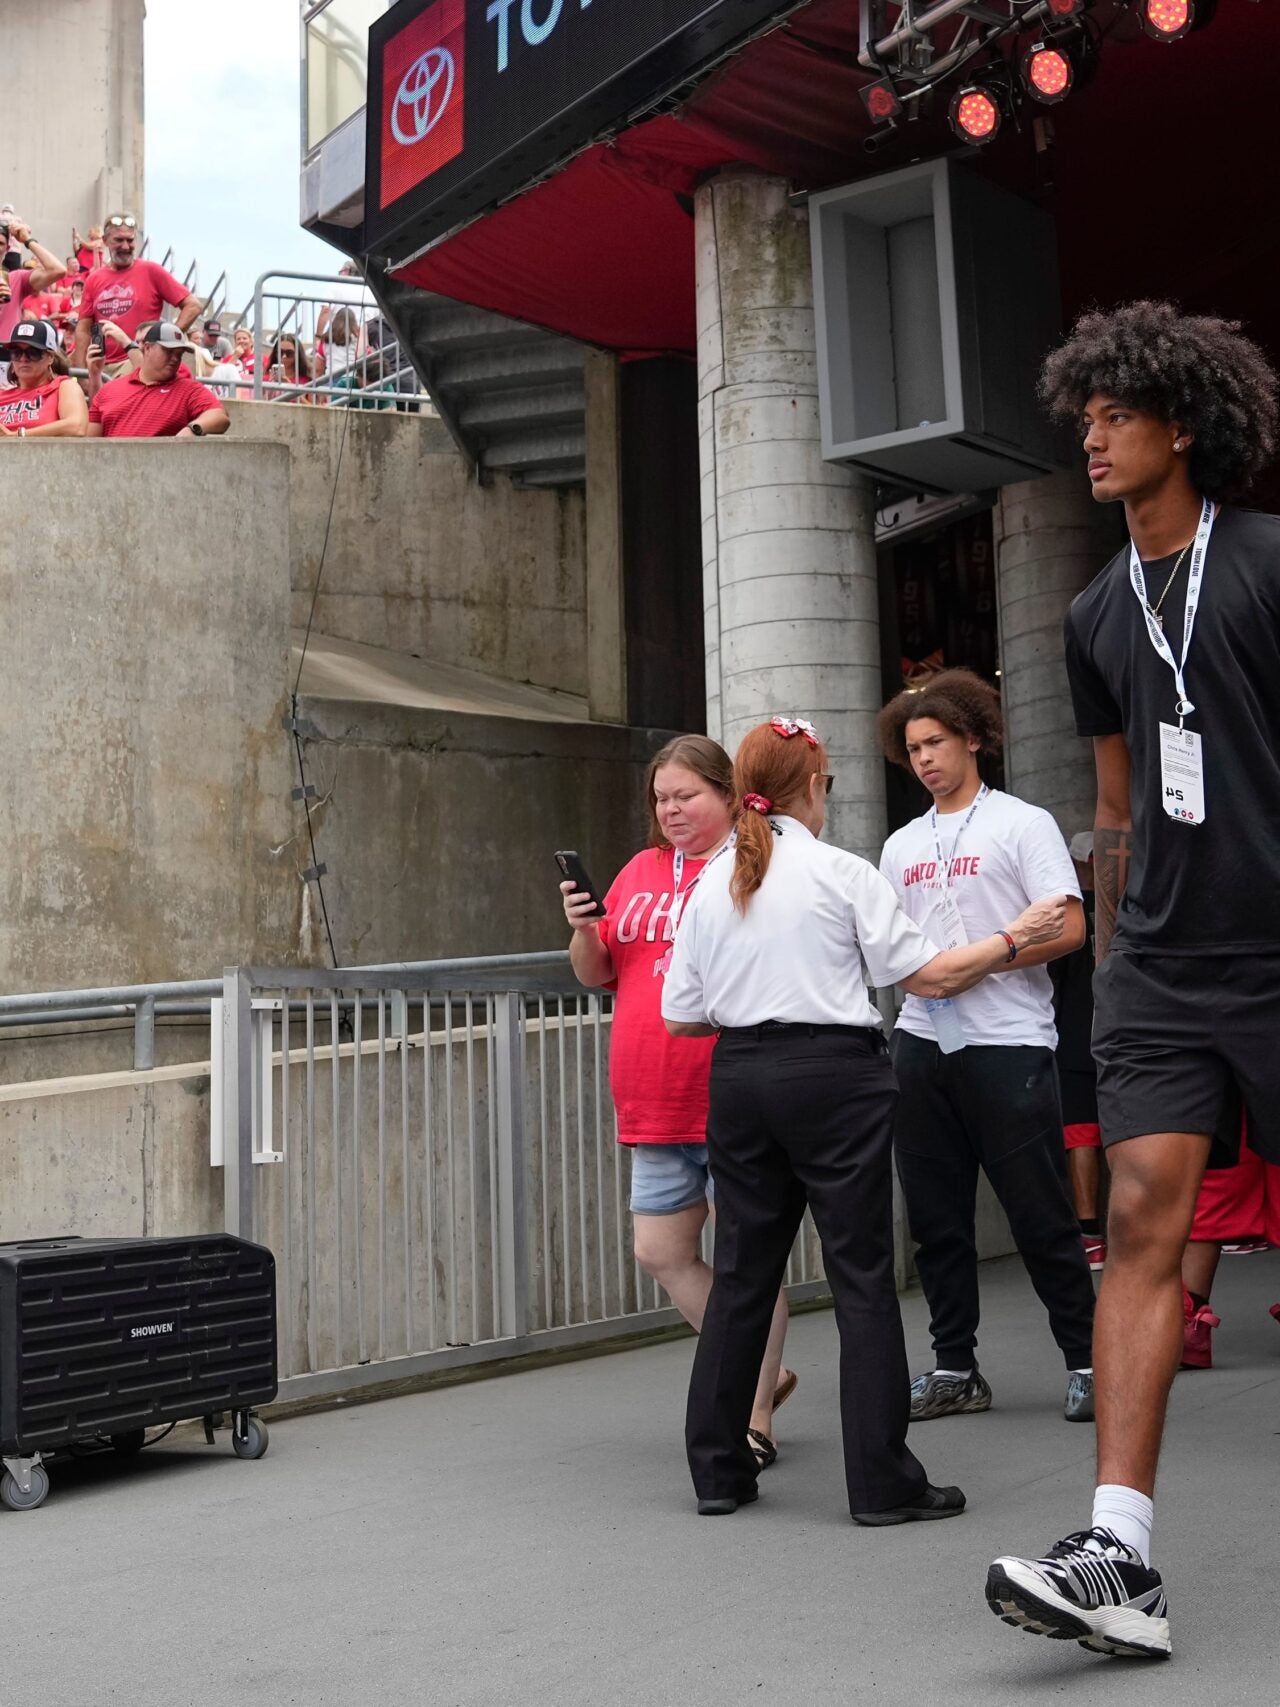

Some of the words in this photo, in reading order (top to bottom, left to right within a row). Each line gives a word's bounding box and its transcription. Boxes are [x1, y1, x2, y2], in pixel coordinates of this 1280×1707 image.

[486, 0, 593, 73] TO
[904, 862, 936, 887] OHIO
[939, 856, 980, 878] TATE
[131, 1322, 173, 1338] SHOWVEN
